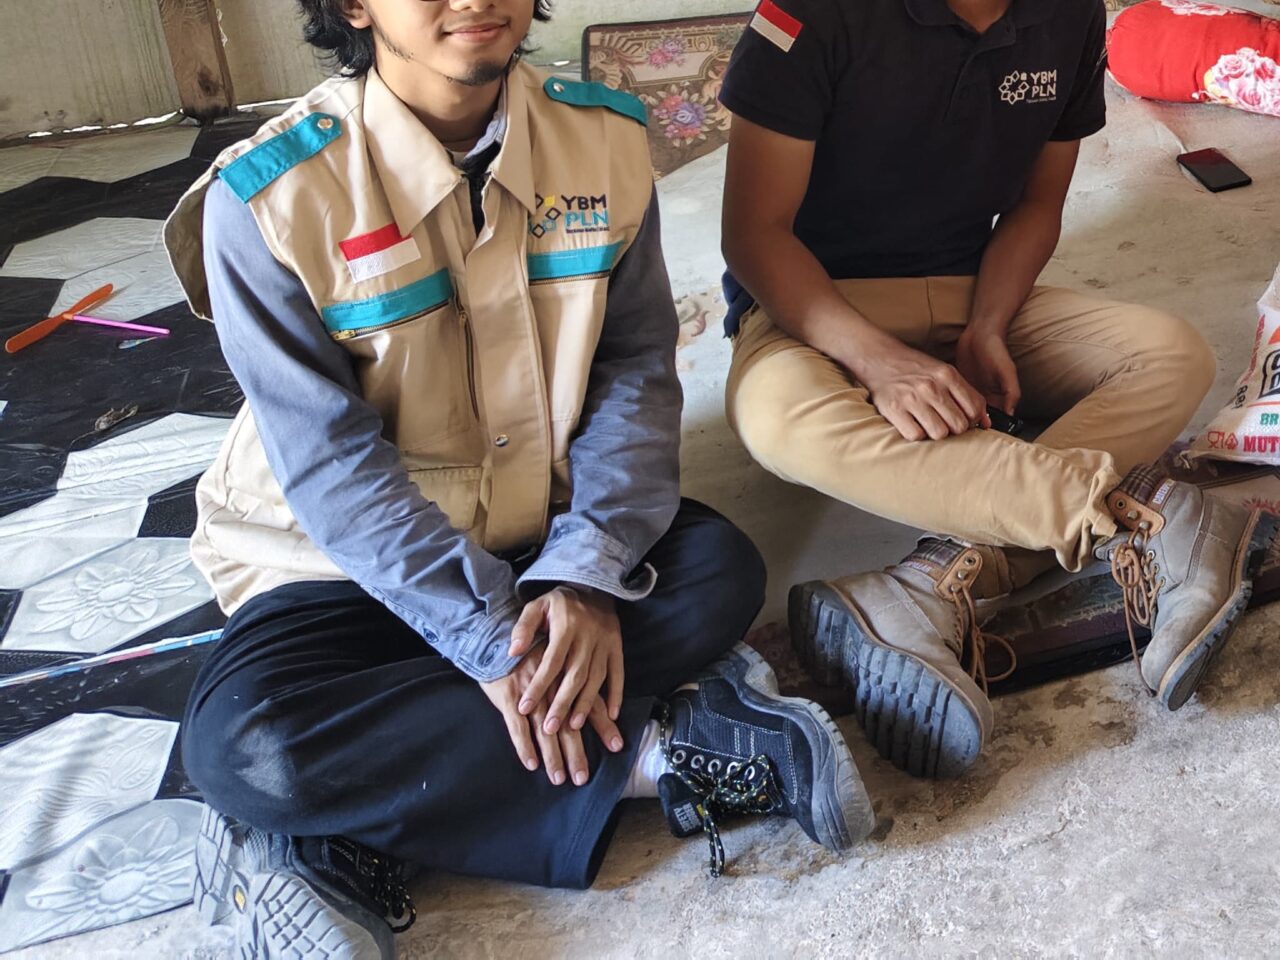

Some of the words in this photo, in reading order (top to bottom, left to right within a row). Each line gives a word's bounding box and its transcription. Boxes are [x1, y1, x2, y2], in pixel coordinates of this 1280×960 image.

[1030, 69, 1057, 85] YBM
[1031, 83, 1057, 98] PLN
[561, 194, 607, 210] YBM
[565, 209, 609, 226] PLN
